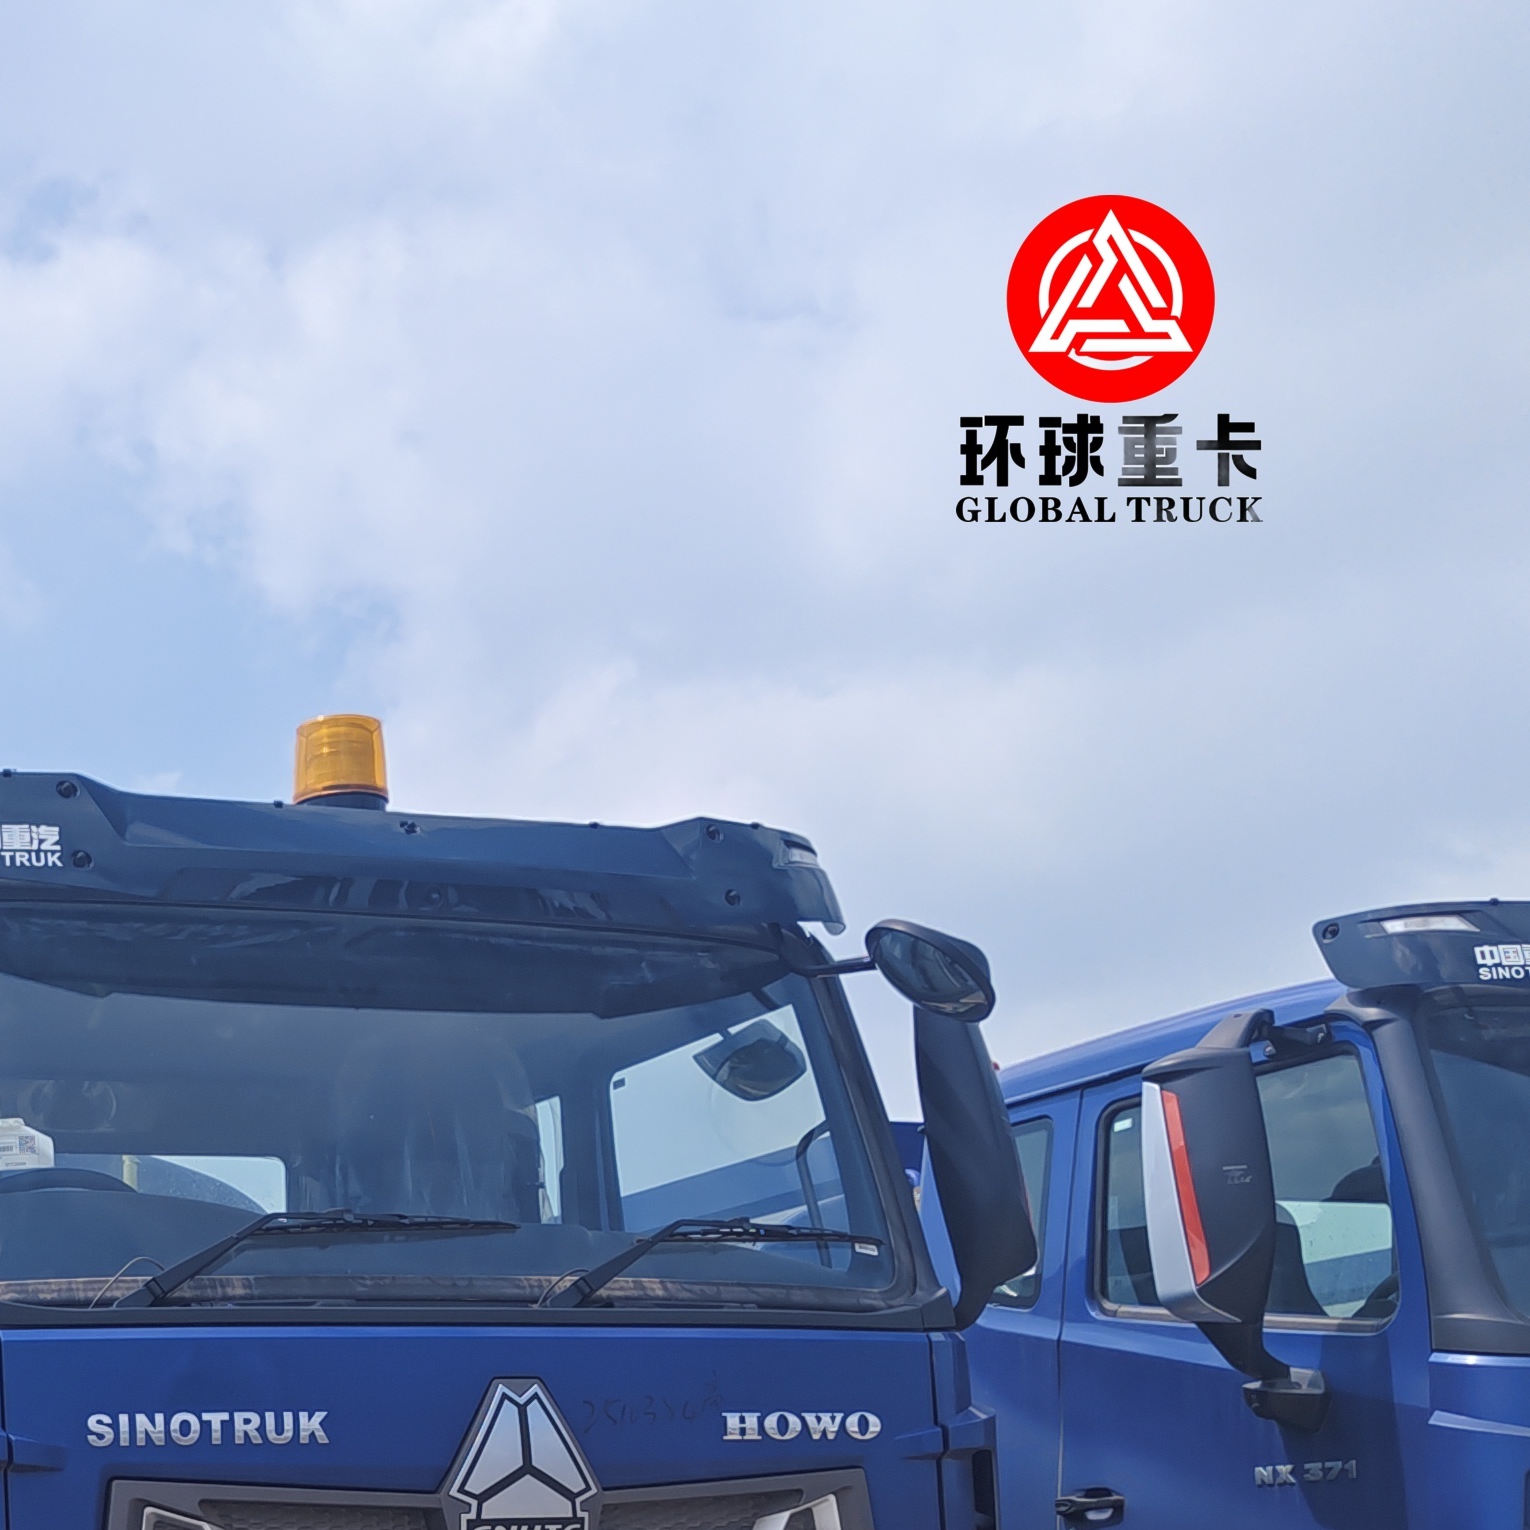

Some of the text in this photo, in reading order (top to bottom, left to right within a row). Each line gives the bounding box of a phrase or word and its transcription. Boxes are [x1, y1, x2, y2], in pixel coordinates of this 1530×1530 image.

[86, 1411, 330, 1447] SINOTRUK
[721, 1411, 882, 1440] HOWO
[1254, 1459, 1357, 1486] NX 371
